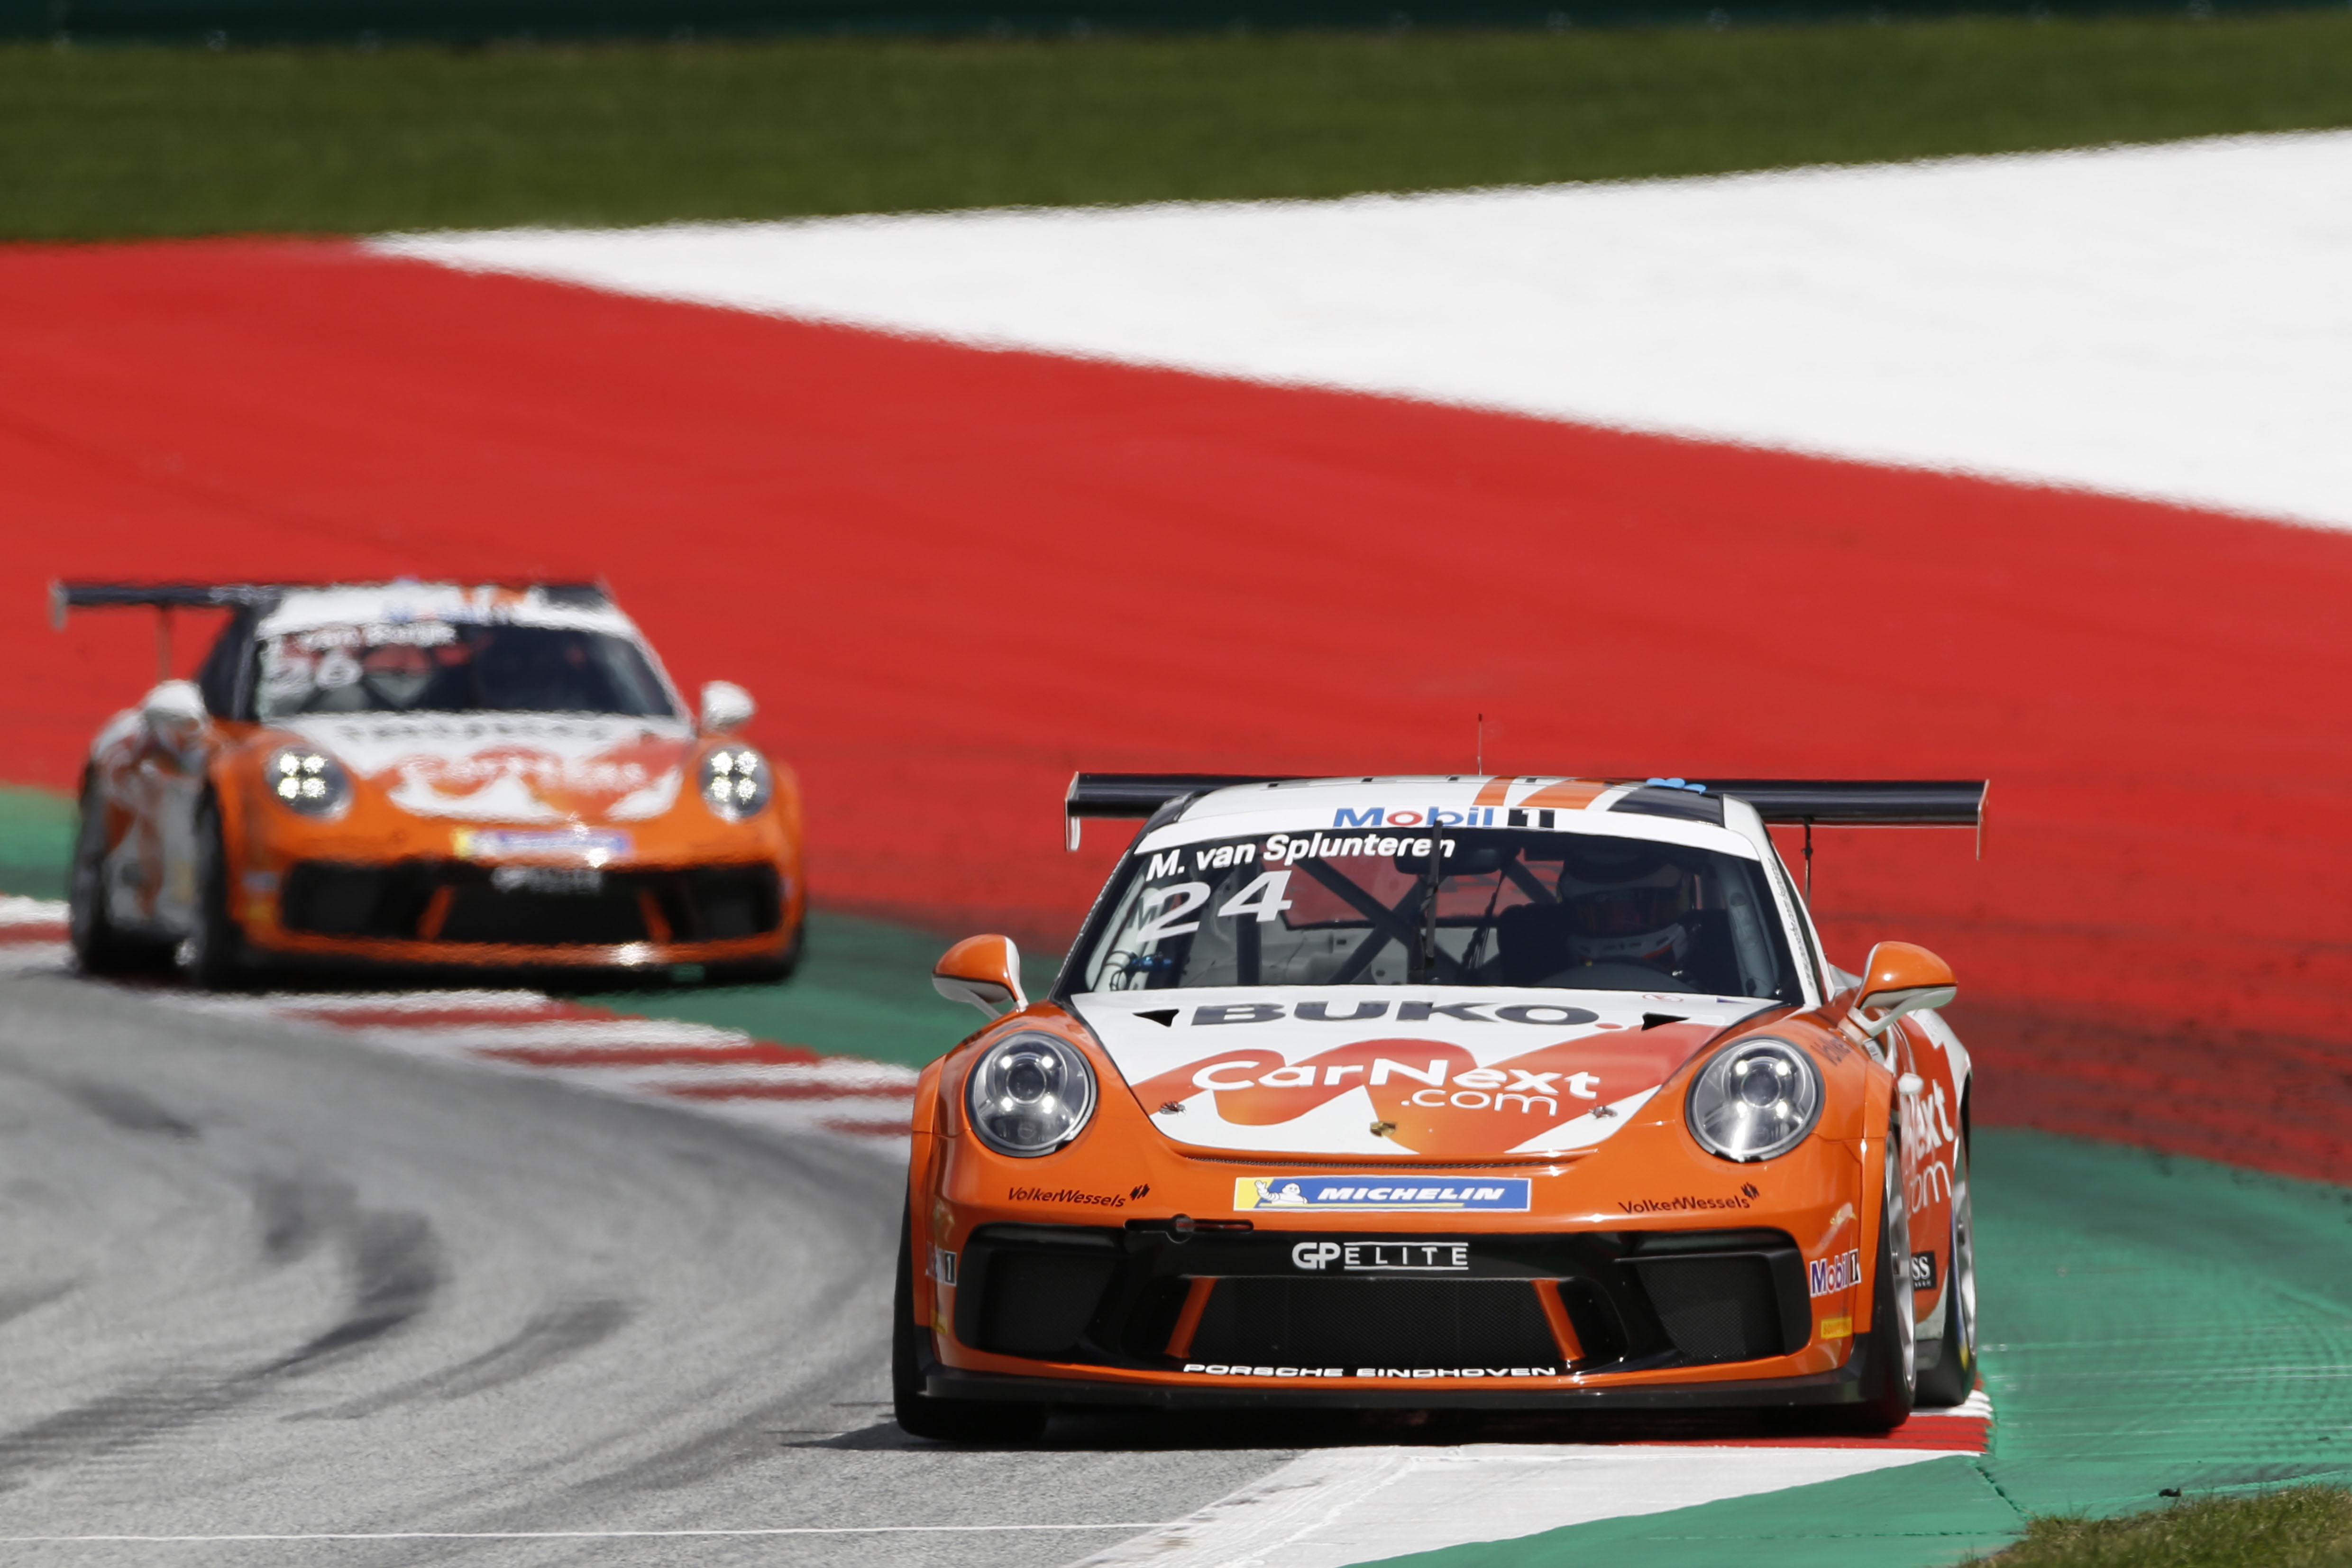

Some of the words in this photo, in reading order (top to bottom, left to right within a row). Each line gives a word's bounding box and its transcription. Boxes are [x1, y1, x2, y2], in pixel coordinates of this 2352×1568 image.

[1333, 807, 1493, 827] Mobil
[1146, 849, 1185, 881] M.
[1197, 844, 1256, 871] van
[1263, 832, 1455, 866] Splunteren
[1136, 871, 1293, 943] 24
[1192, 1058, 1600, 1099] CarNext
[1401, 1089, 1558, 1116] .com
[1008, 1187, 1126, 1207] VolkerWessels
[1318, 1187, 1505, 1201] MICHELIN
[1618, 1195, 1750, 1214] VolkerWessels
[1291, 1242, 1341, 1269] GP
[1345, 1247, 1468, 1265] ELITE
[1810, 1252, 1849, 1298] Mobil
[1183, 1364, 1344, 1377] PORSCHE
[1356, 1367, 1556, 1377] EINDHOVEN
